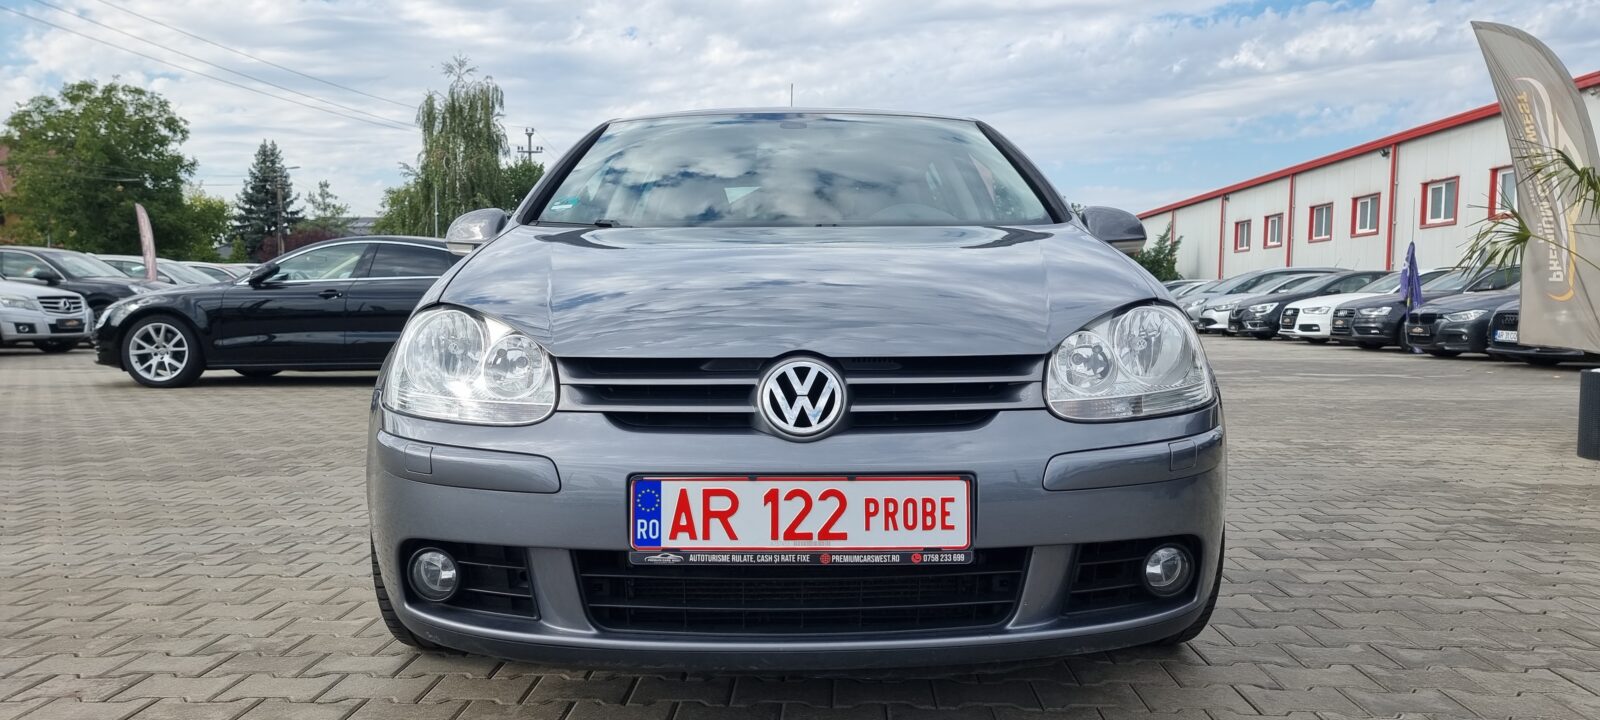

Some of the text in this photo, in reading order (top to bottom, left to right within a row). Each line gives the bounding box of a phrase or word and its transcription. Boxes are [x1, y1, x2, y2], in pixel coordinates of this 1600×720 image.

[668, 488, 956, 541] AR 122 PROBE
[636, 518, 660, 540] RO
[688, 554, 730, 562] AUTOTURISME
[731, 554, 756, 563] RULATE,
[756, 554, 773, 563] CASH
[781, 554, 796, 563] RATE
[796, 554, 811, 563] FIXE
[831, 554, 900, 563] PREMIUMCARSWEST.RO
[923, 553, 939, 562] 0758
[939, 553, 952, 562] 233
[952, 553, 965, 562] 699
